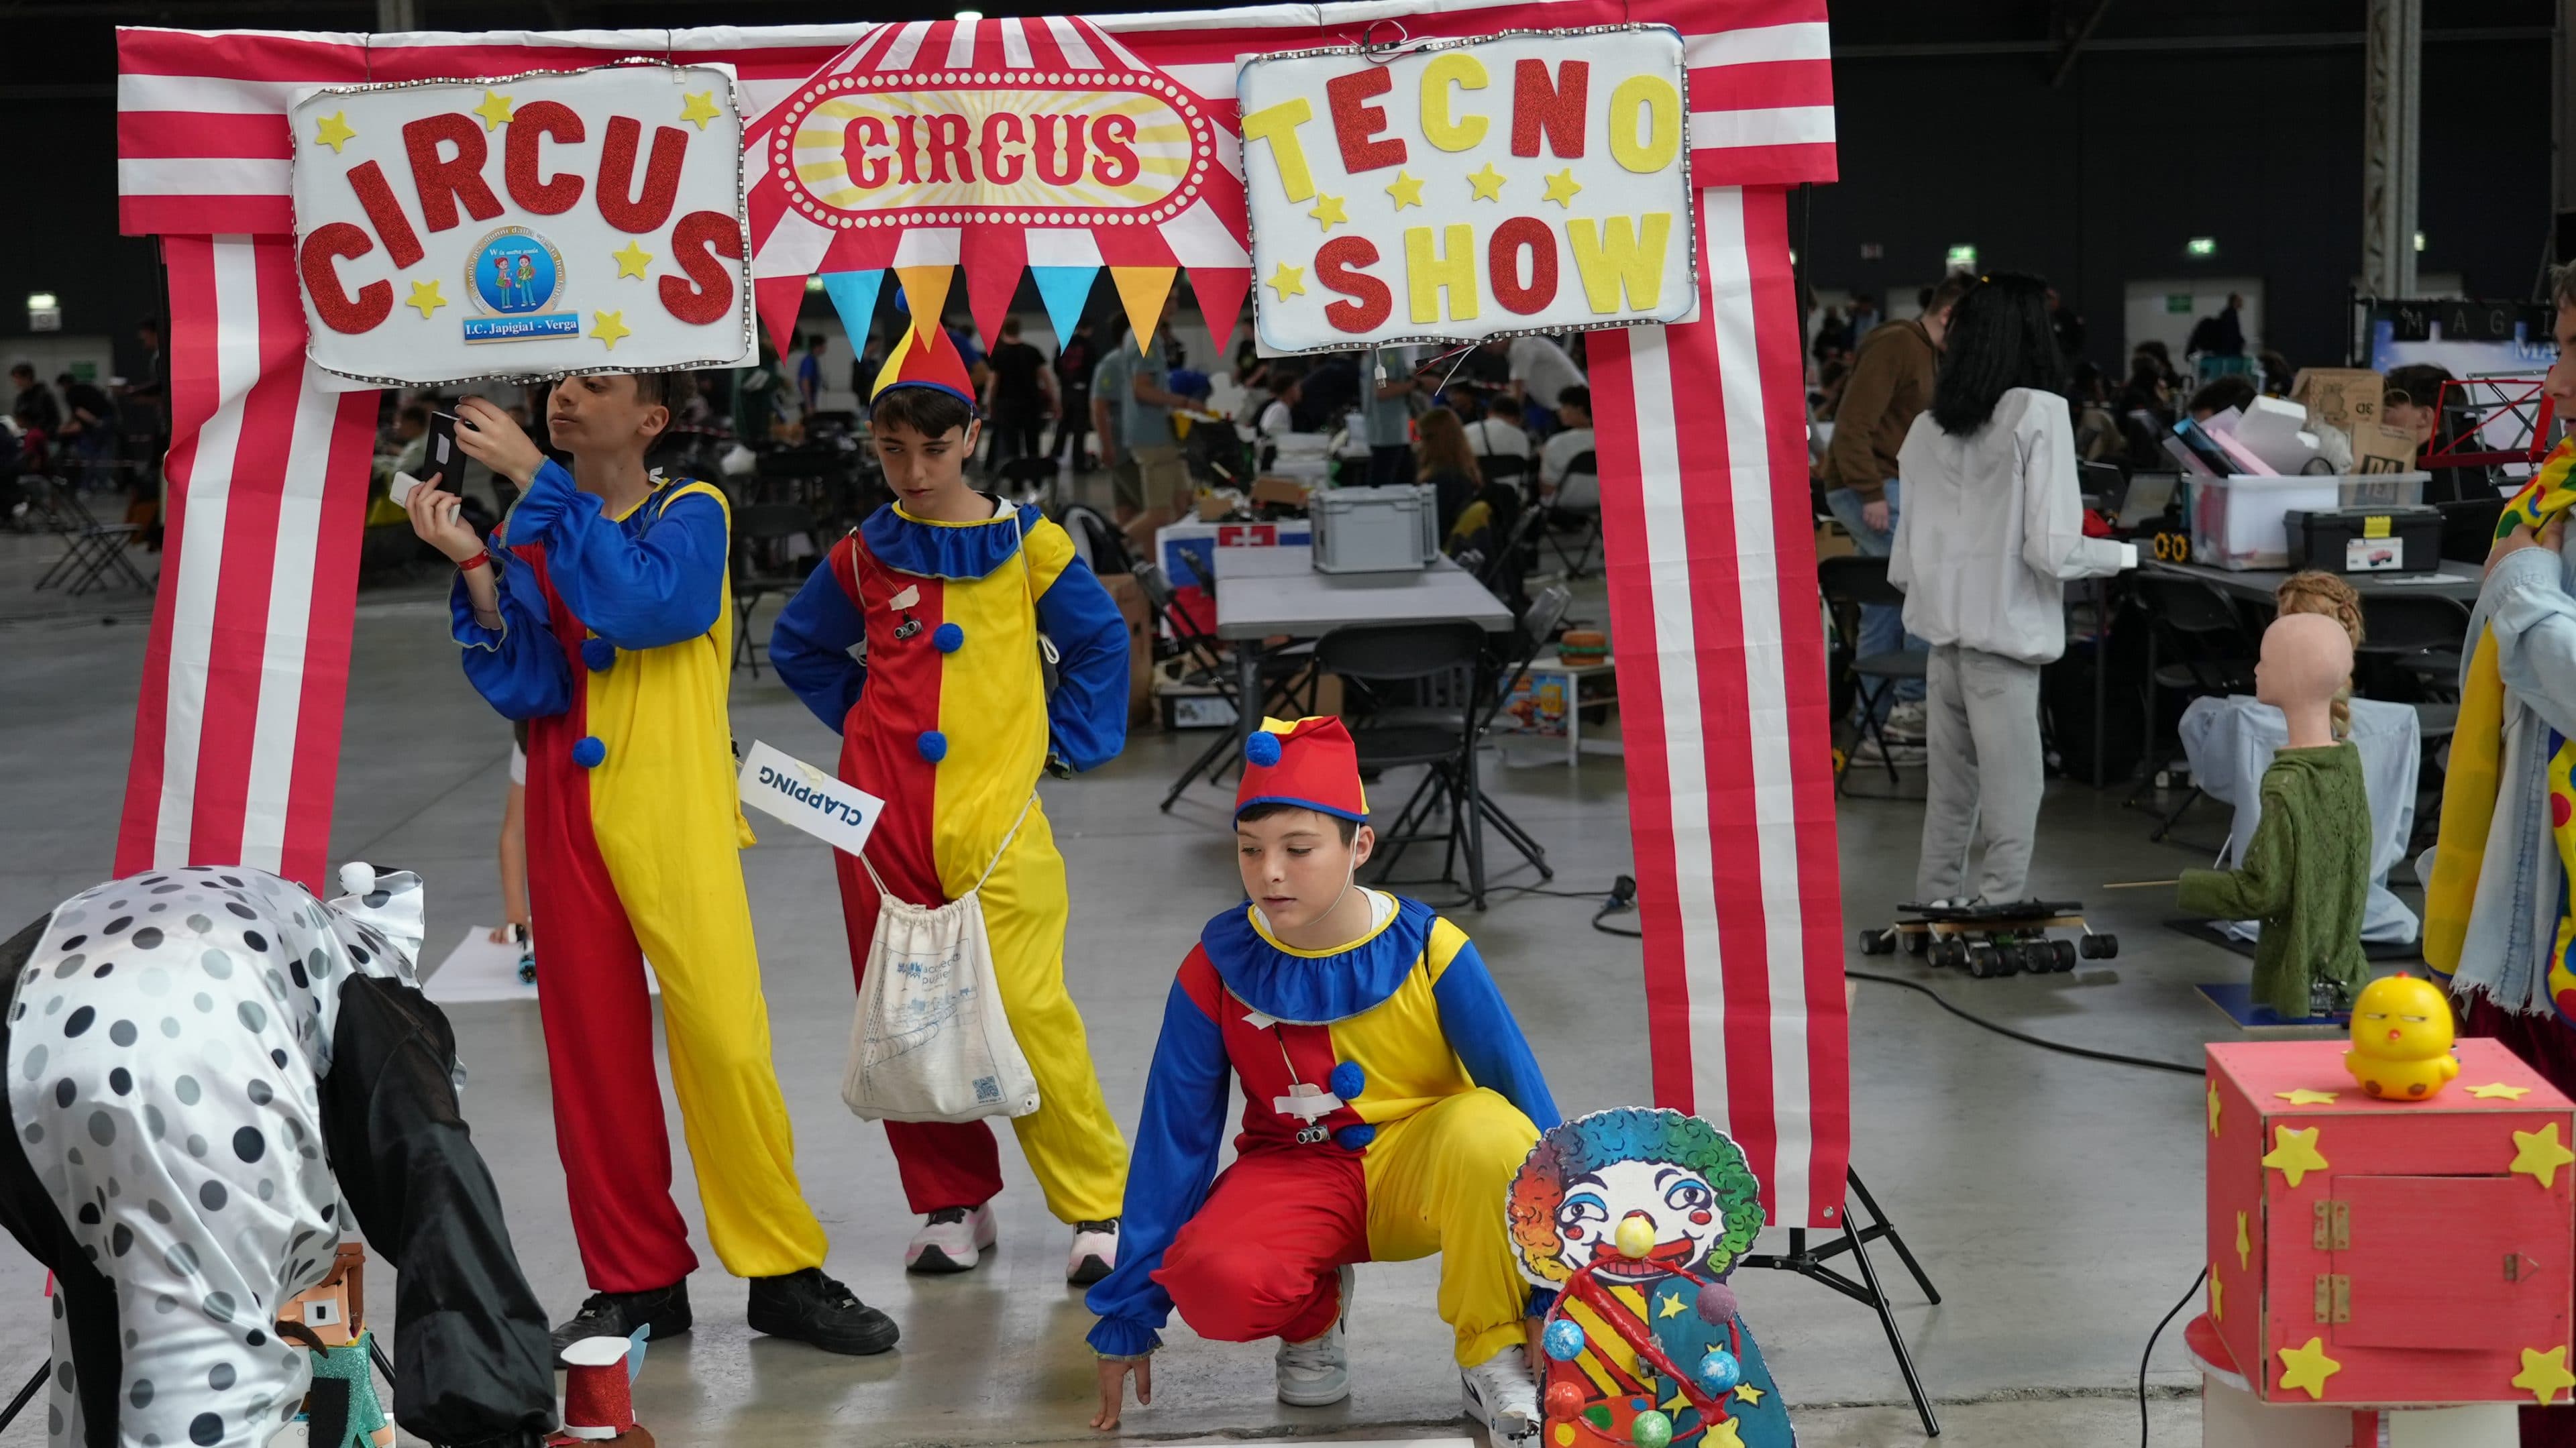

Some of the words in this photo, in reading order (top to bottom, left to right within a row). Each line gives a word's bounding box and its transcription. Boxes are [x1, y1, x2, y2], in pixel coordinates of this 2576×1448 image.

[841, 113, 1140, 189] CIRCUS
[1242, 54, 1678, 203] TECNO
[301, 100, 743, 334] CIRCUS
[1314, 213, 1671, 333] SHOW
[466, 323, 486, 335] I.C.
[545, 319, 577, 331] Verga
[759, 765, 863, 826] CLAPPING
